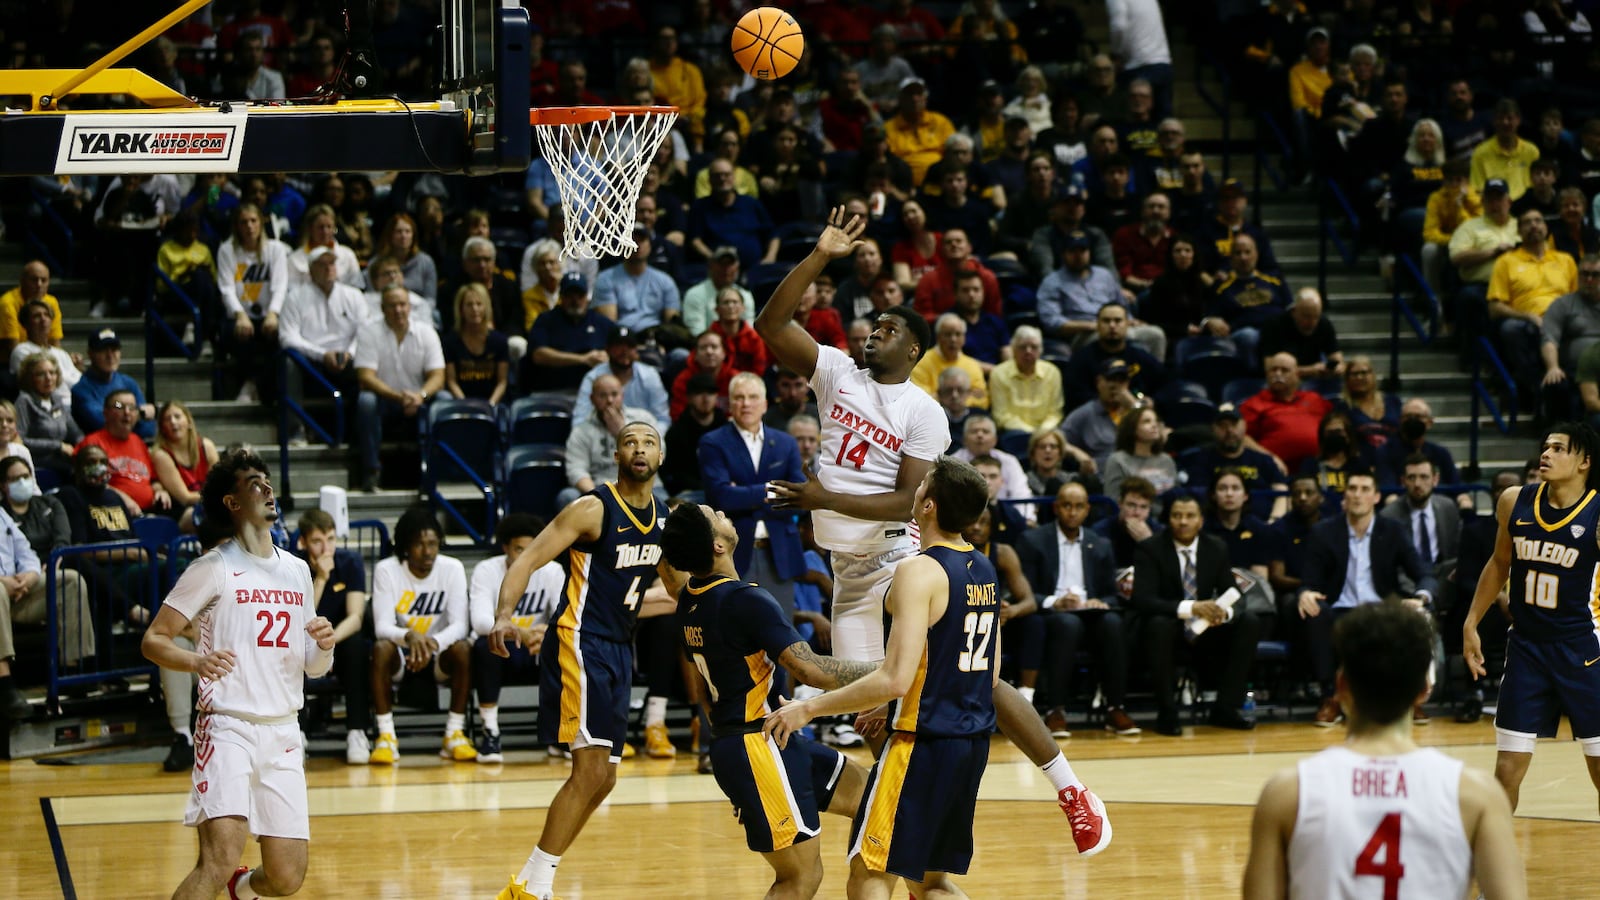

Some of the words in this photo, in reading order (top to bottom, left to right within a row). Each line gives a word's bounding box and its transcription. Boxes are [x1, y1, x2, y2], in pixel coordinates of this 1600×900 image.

[79, 133, 152, 154] YARK
[150, 138, 223, 149] AUTO.COM
[830, 404, 904, 452] DAYTON
[835, 431, 871, 471] 14
[615, 543, 663, 570] TOLEDO
[1512, 535, 1580, 569] TOLEDO
[234, 588, 304, 607] DAYTON
[395, 589, 446, 616] BALL
[512, 589, 546, 616] ALL
[623, 576, 642, 611] 4
[965, 582, 997, 607] SUMATE
[1524, 569, 1560, 610] 10
[256, 610, 291, 649] 22
[957, 611, 995, 673] 32
[1352, 767, 1409, 799] BREA
[1353, 811, 1406, 900] 4
